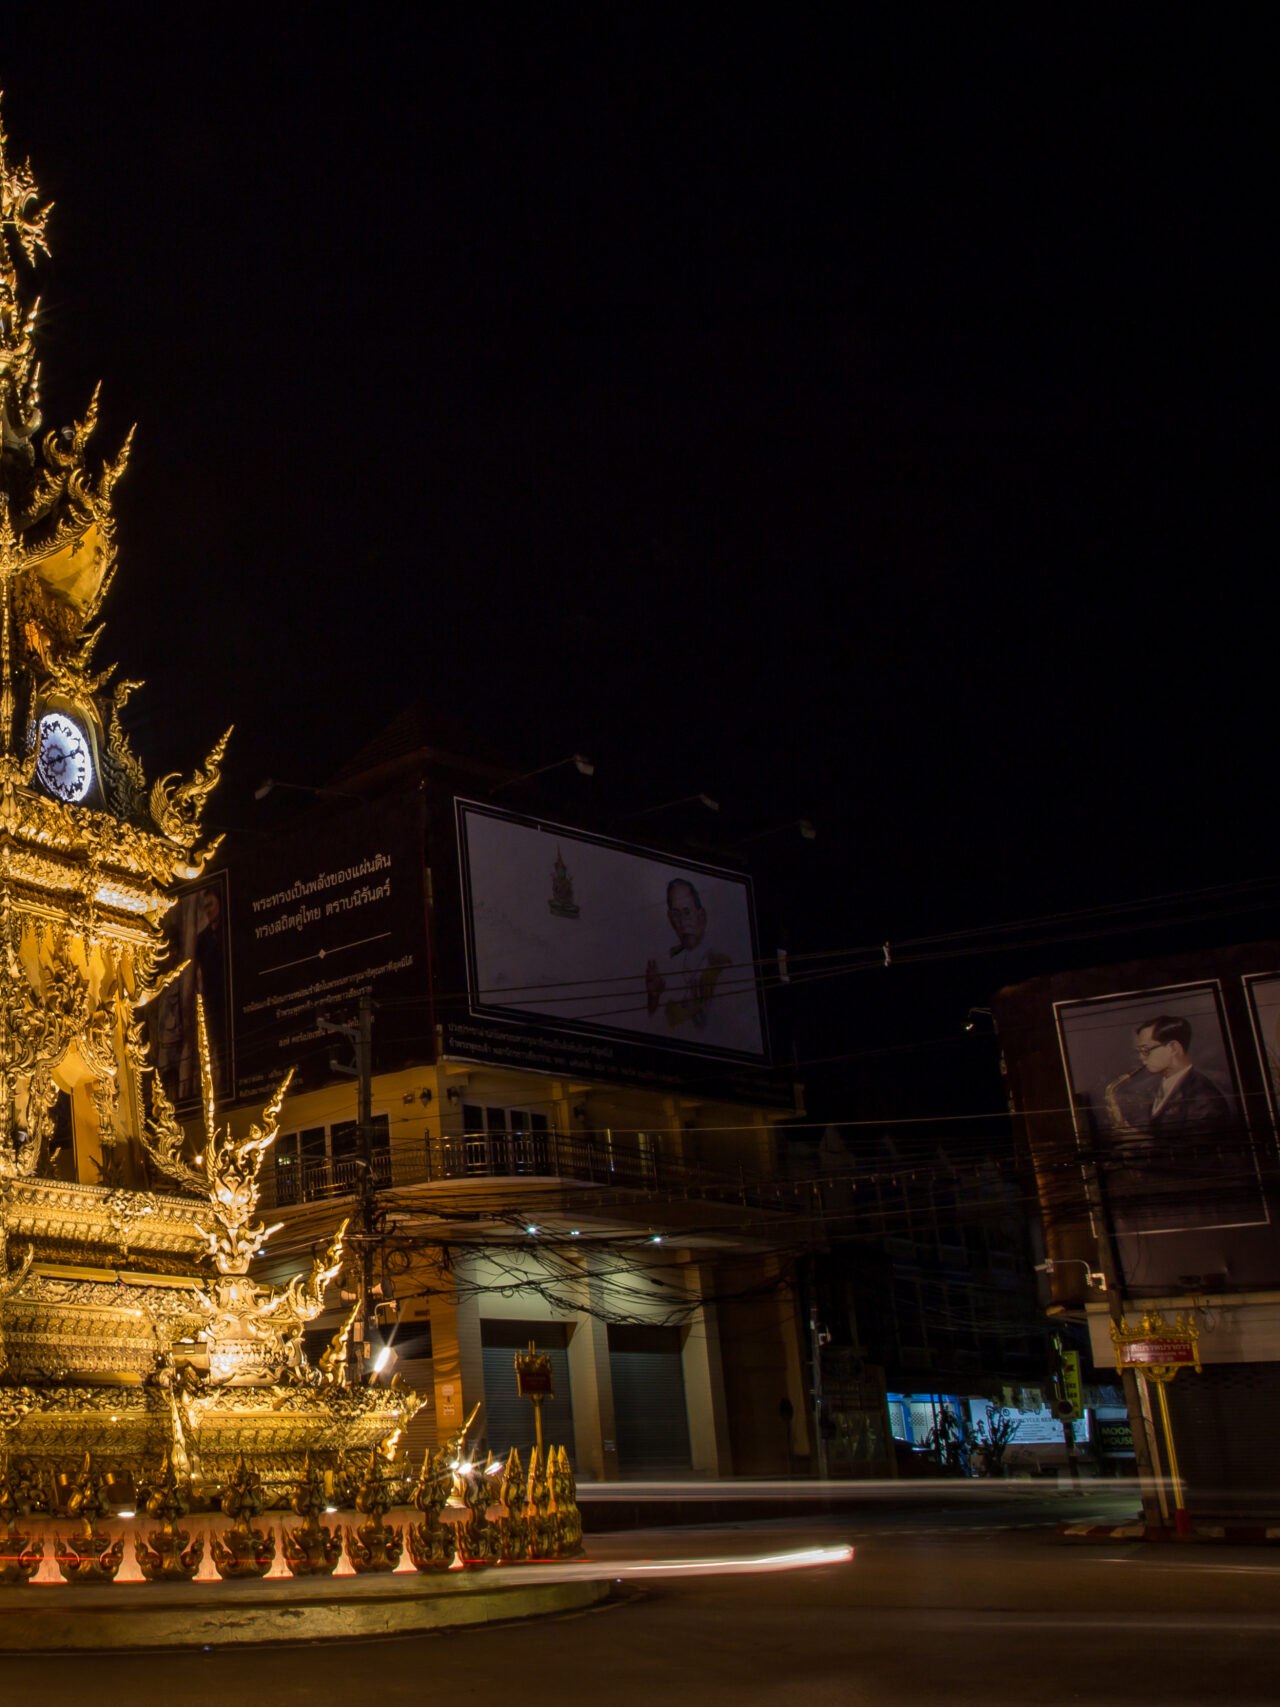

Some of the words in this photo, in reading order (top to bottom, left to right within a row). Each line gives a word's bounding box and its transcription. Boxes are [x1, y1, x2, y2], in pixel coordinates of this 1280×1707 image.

[252, 852, 392, 913] พระทรงเป็นพลังของแผ่นดิน
